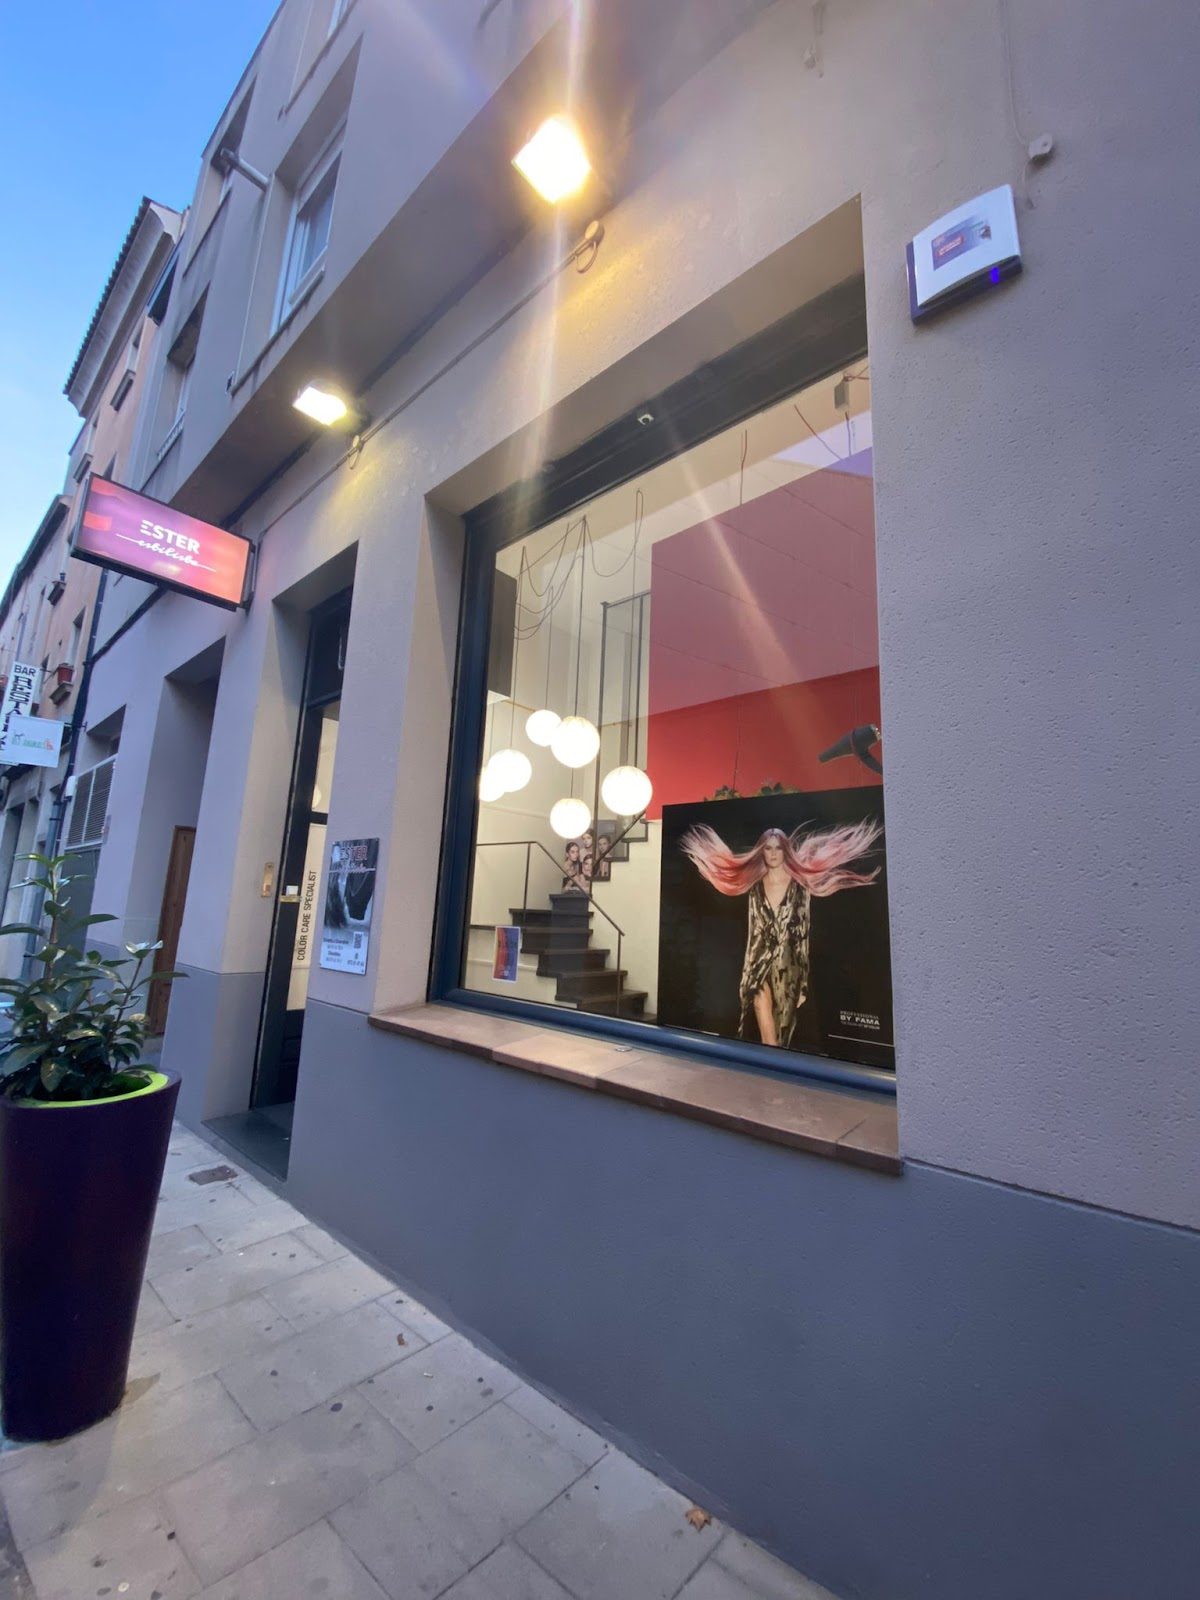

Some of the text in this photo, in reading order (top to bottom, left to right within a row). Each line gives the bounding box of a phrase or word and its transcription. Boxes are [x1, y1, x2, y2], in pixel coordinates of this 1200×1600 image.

[140, 519, 200, 555] ESTER
[14, 664, 36, 676] BAR
[297, 871, 317, 961] COLOR CARE SPECIALIST
[855, 1016, 880, 1026] FAMA
